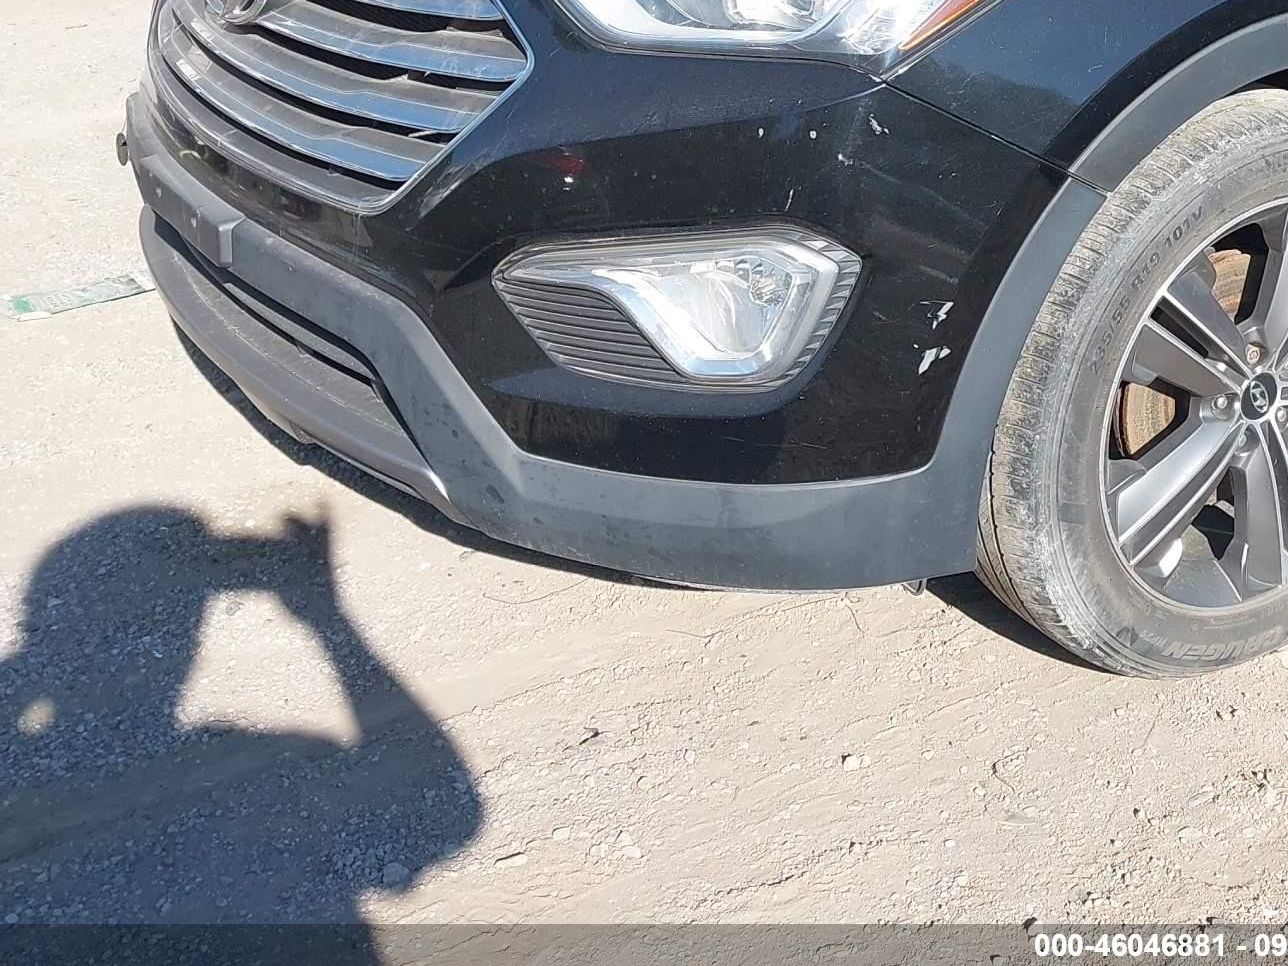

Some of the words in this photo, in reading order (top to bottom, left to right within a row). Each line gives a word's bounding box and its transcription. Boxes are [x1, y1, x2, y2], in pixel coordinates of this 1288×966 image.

[1090, 295, 1131, 376] 235/55
[1131, 251, 1161, 292] R19
[1163, 205, 1205, 249] 101V
